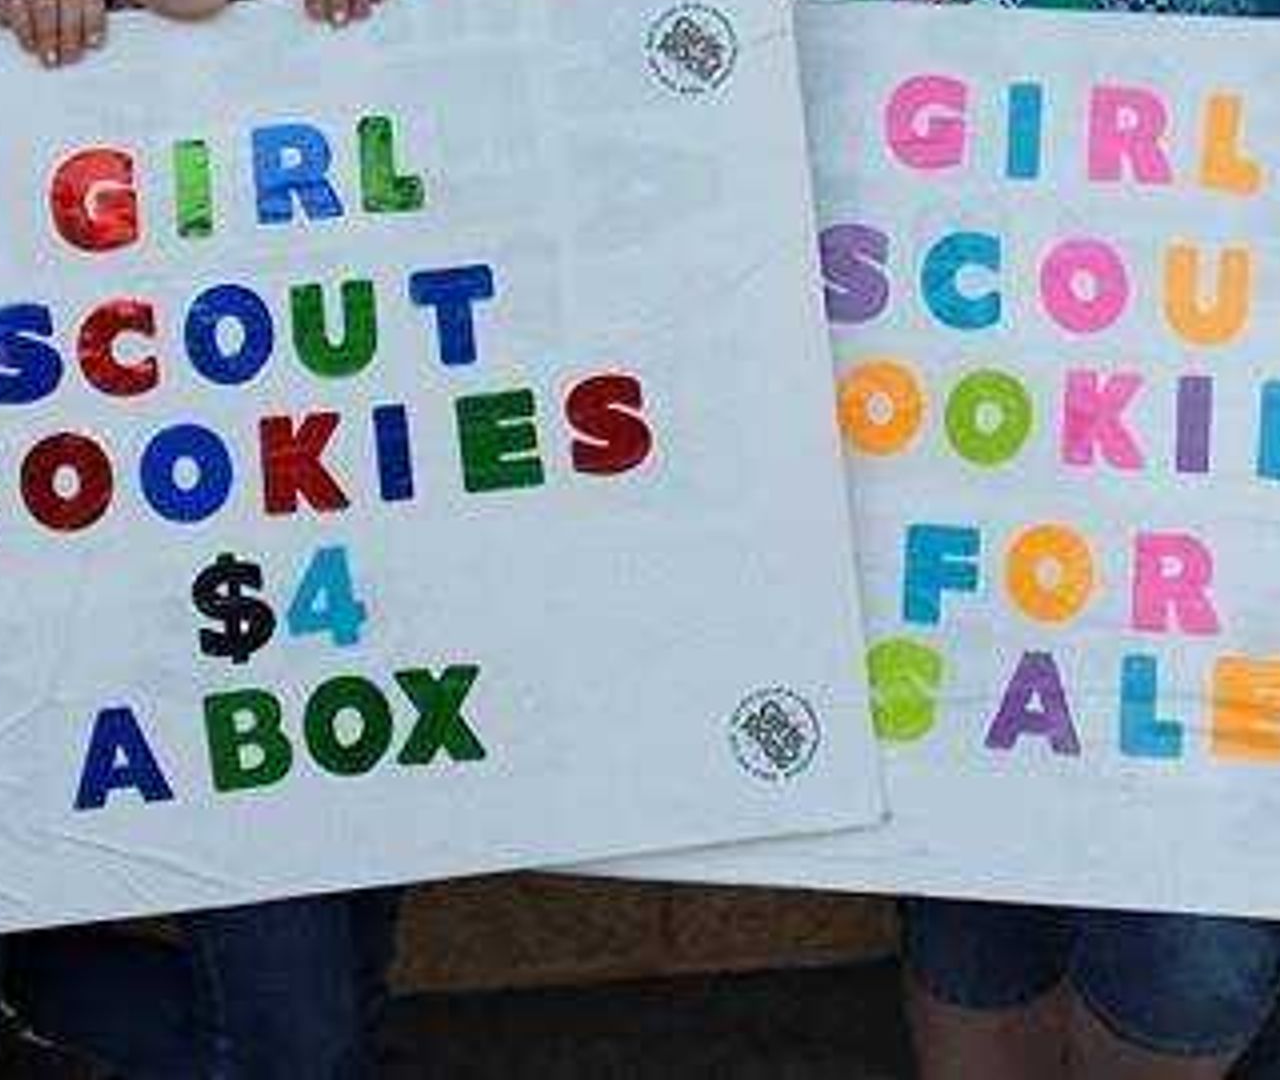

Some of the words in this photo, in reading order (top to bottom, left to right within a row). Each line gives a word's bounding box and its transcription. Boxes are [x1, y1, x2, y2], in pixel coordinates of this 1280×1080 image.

[50, 116, 422, 253] GIRL
[884, 75, 1263, 194] GIRL
[192, 542, 369, 664] $4
[898, 521, 1220, 634] FOR
[74, 706, 173, 811] A
[204, 665, 487, 792] BOX
